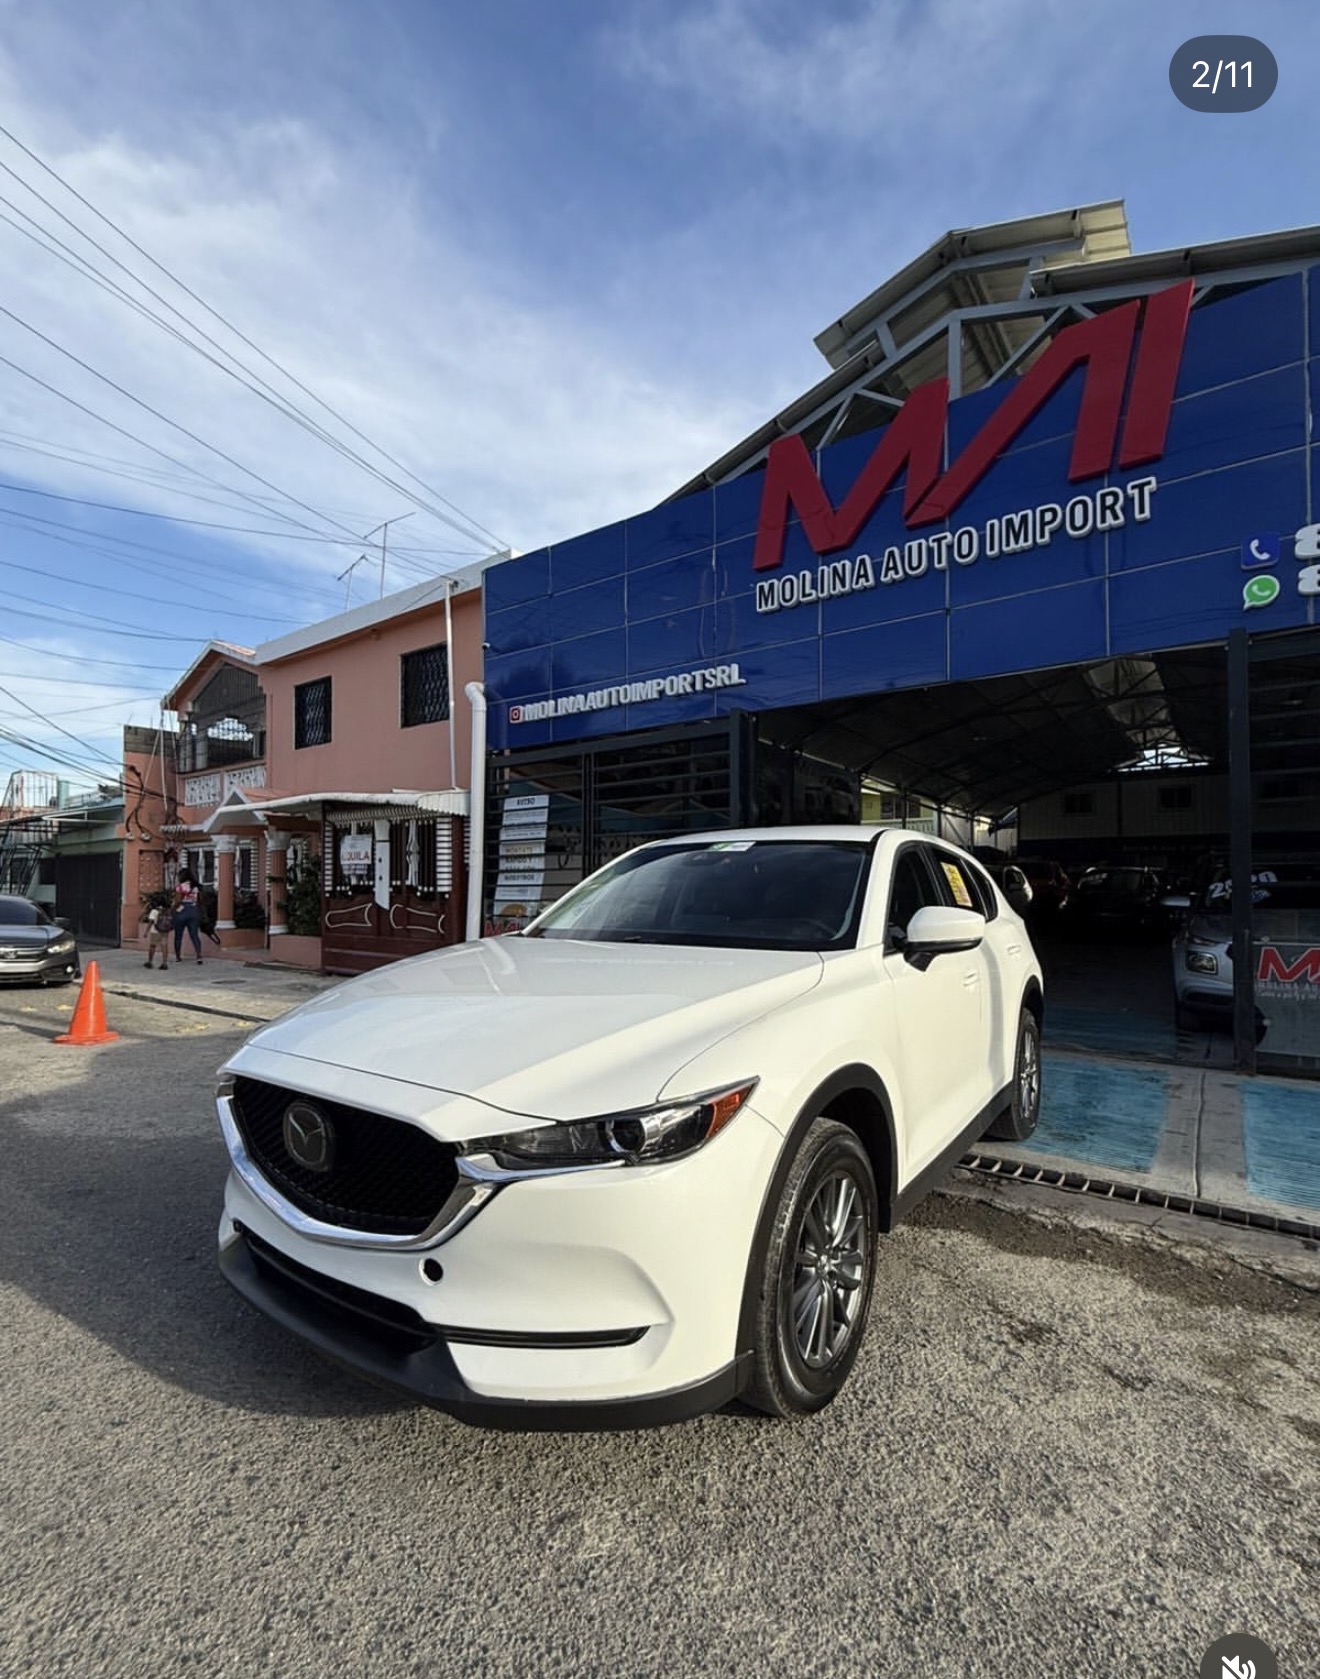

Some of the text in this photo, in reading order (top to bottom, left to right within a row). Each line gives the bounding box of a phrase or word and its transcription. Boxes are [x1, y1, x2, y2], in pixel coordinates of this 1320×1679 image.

[756, 477, 1157, 613] MOLINA AUTO IMPORT
